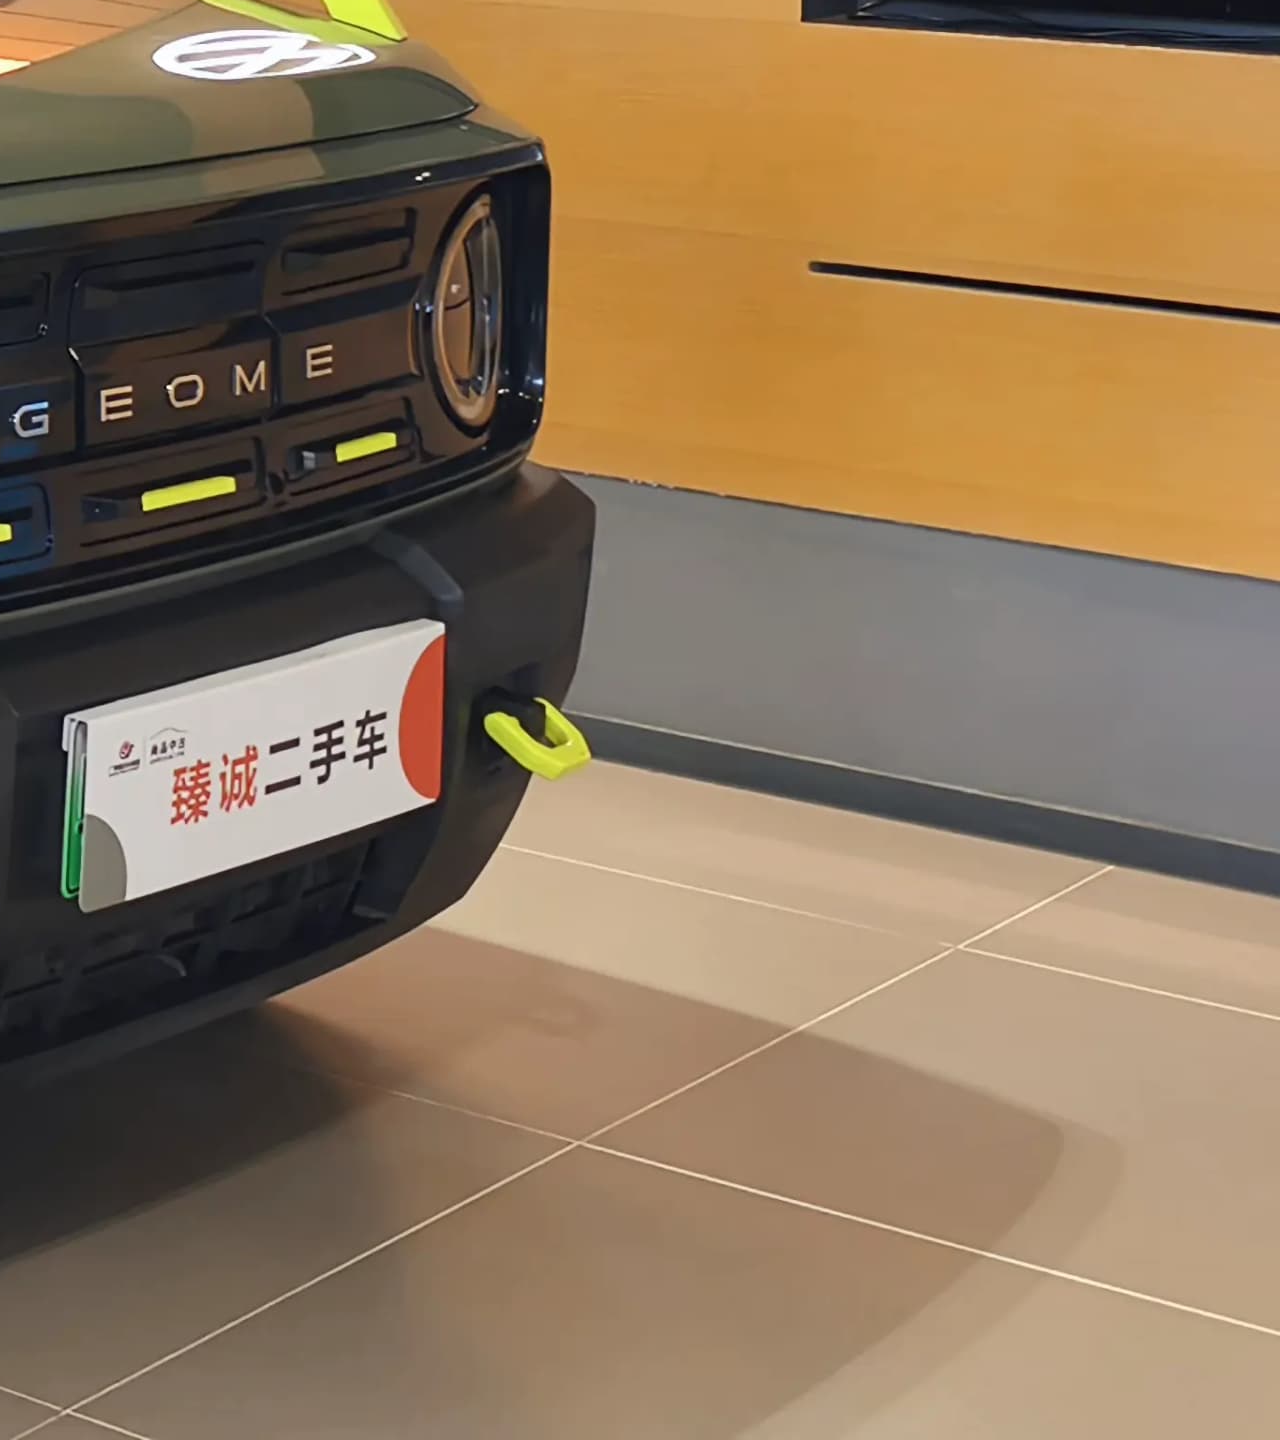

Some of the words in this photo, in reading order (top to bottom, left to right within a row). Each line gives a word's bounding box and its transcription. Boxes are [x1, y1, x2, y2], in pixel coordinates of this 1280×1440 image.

[11, 344, 334, 438] GEOME
[170, 709, 388, 825] 臻诚二手车
